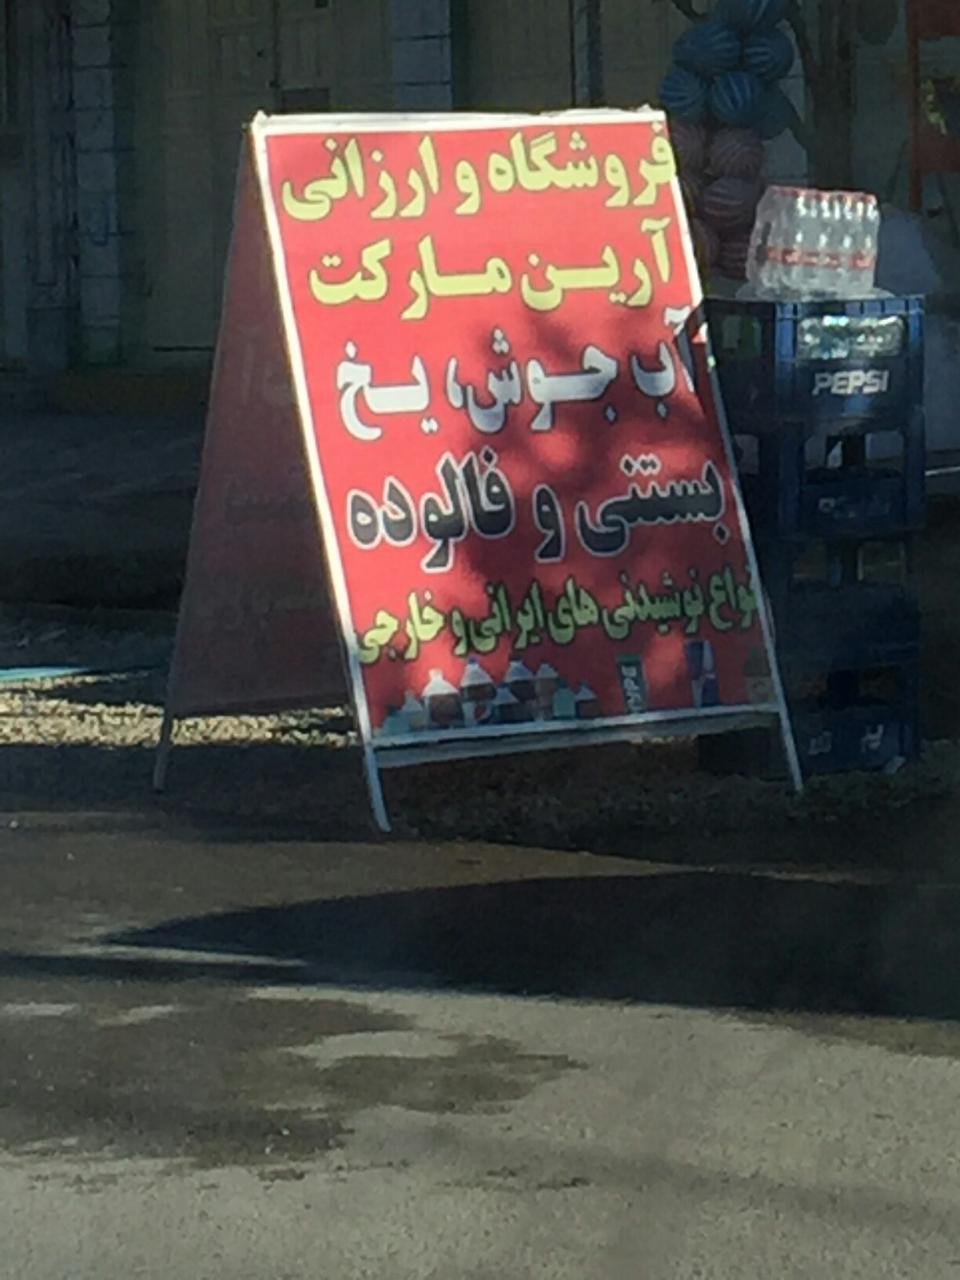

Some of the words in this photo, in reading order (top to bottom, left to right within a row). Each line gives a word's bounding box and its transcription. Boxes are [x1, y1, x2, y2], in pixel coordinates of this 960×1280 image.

[281, 135, 440, 220] ارزانی
[453, 159, 483, 215] و
[488, 122, 677, 209] فروشگاه
[308, 234, 513, 321] مارکت
[519, 217, 672, 311] آرین
[336, 340, 440, 440] یخ
[811, 369, 890, 397] PEPSI
[346, 447, 516, 572] فالوده
[532, 482, 565, 562] و
[575, 453, 727, 557] بستنی
[360, 589, 445, 664] خارجی
[451, 607, 469, 656] و
[469, 579, 545, 654] ایرانی
[548, 575, 600, 645] های
[602, 567, 704, 639] نوشیدنی
